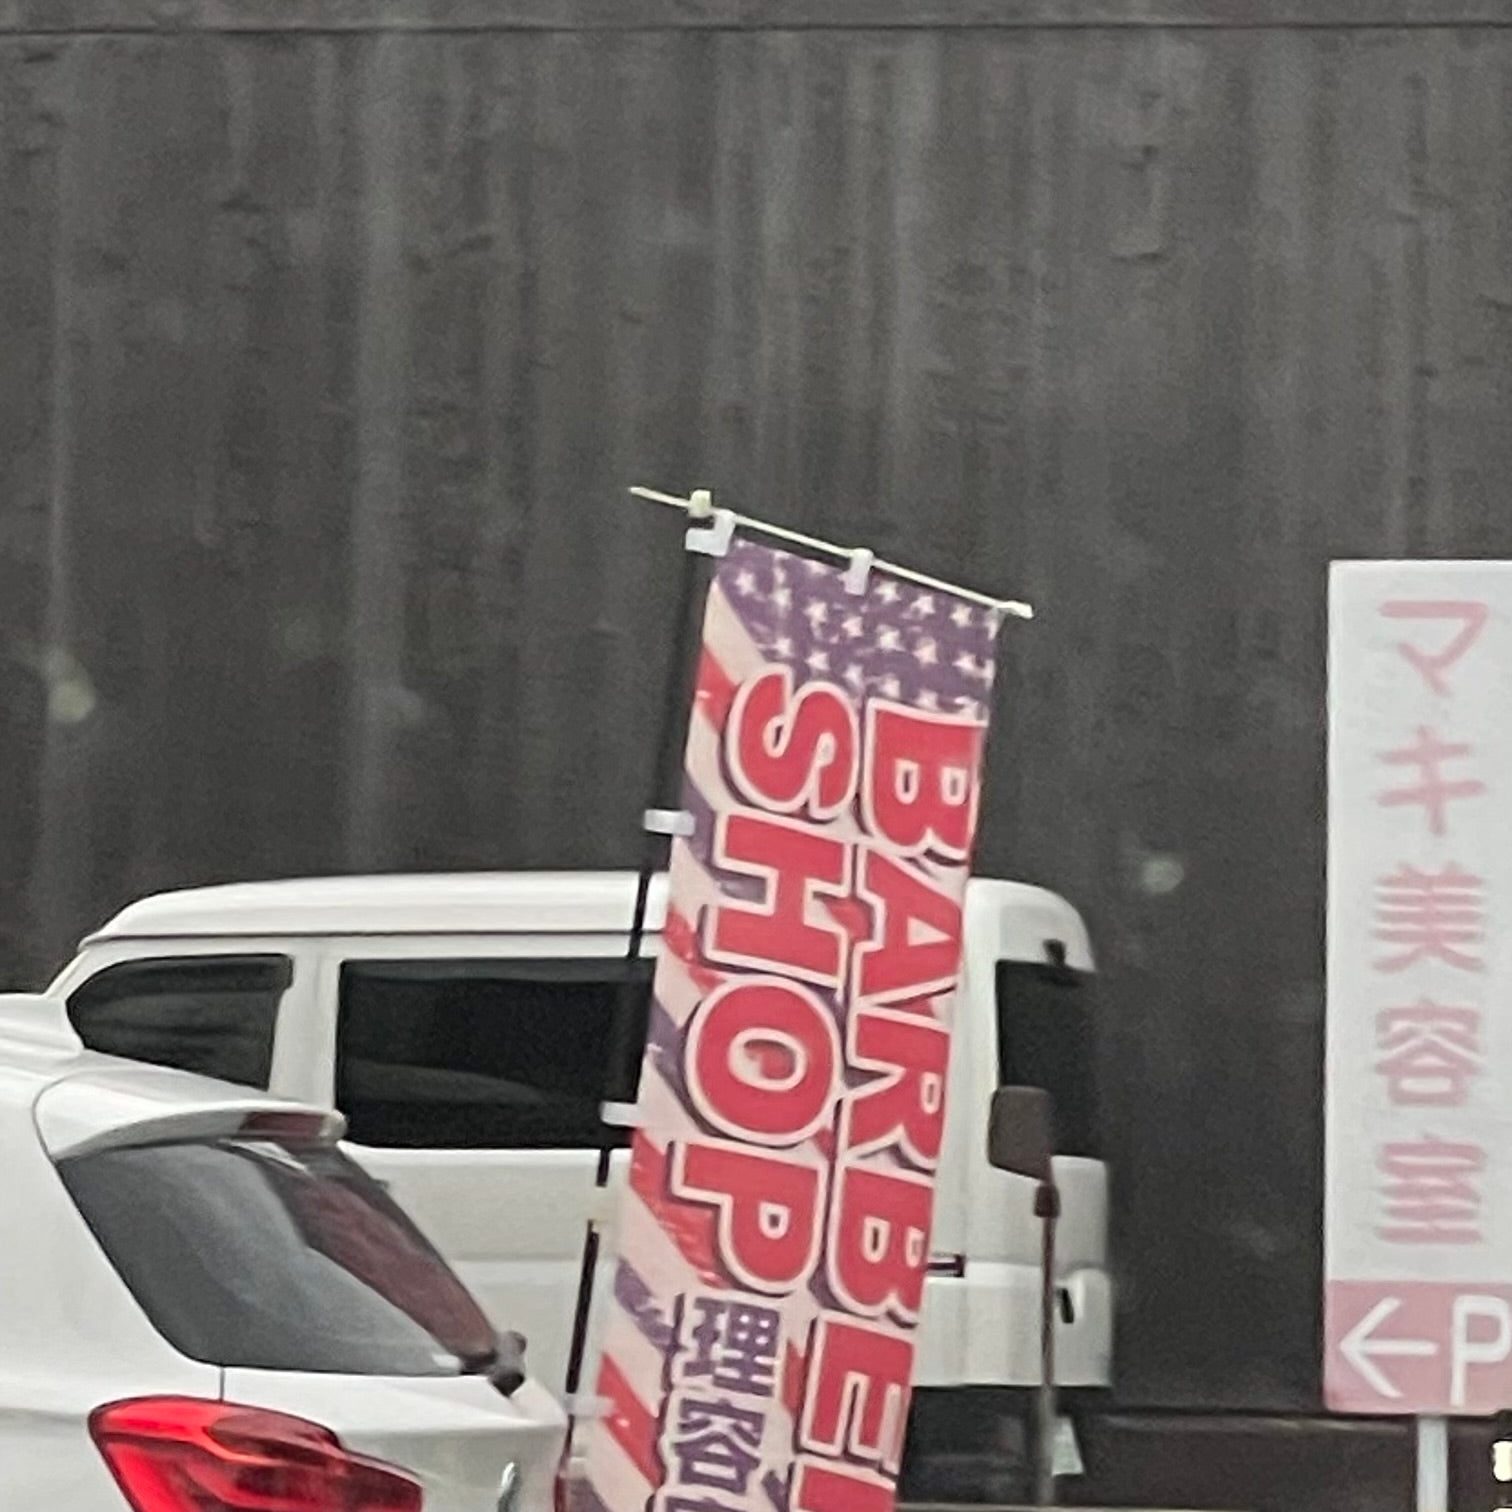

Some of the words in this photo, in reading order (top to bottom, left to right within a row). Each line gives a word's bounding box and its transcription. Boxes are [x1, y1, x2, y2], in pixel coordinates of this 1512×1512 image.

[678, 674, 857, 1293] SHOP
[1371, 598, 1488, 1246] マキ美容室
[664, 1295, 781, 1512] 理容
